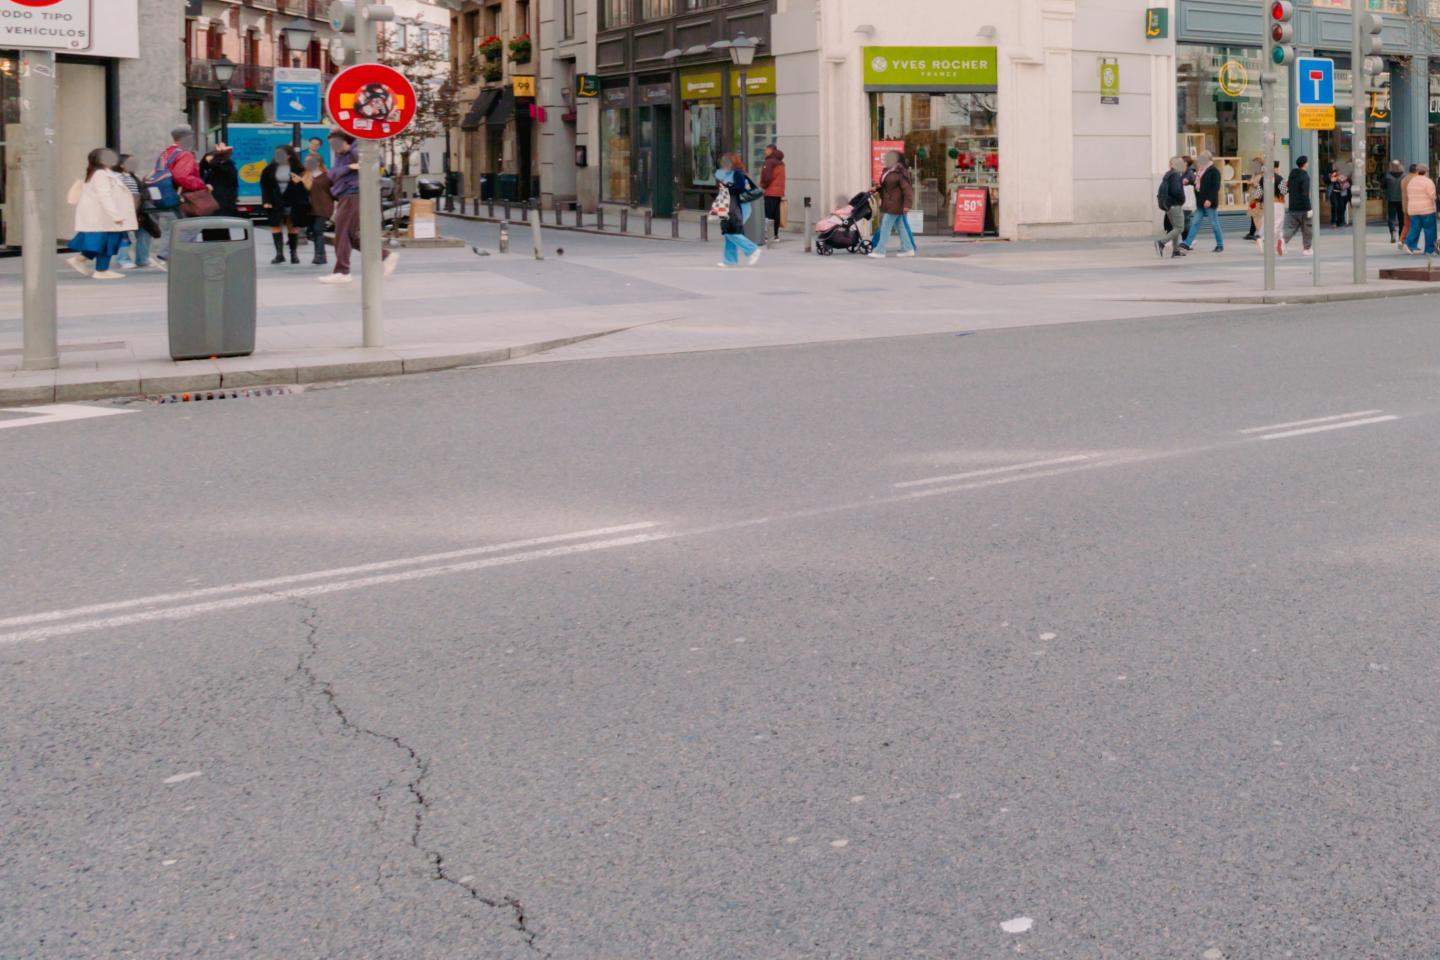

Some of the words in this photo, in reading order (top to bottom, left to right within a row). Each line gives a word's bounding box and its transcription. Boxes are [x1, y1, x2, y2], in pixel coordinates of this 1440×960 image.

[0, 9, 32, 20] ODO
[42, 11, 73, 22] TIPO
[5, 25, 86, 38] VEHÍCULOS
[892, 59, 927, 70] YVES
[932, 59, 989, 70] ROCHER
